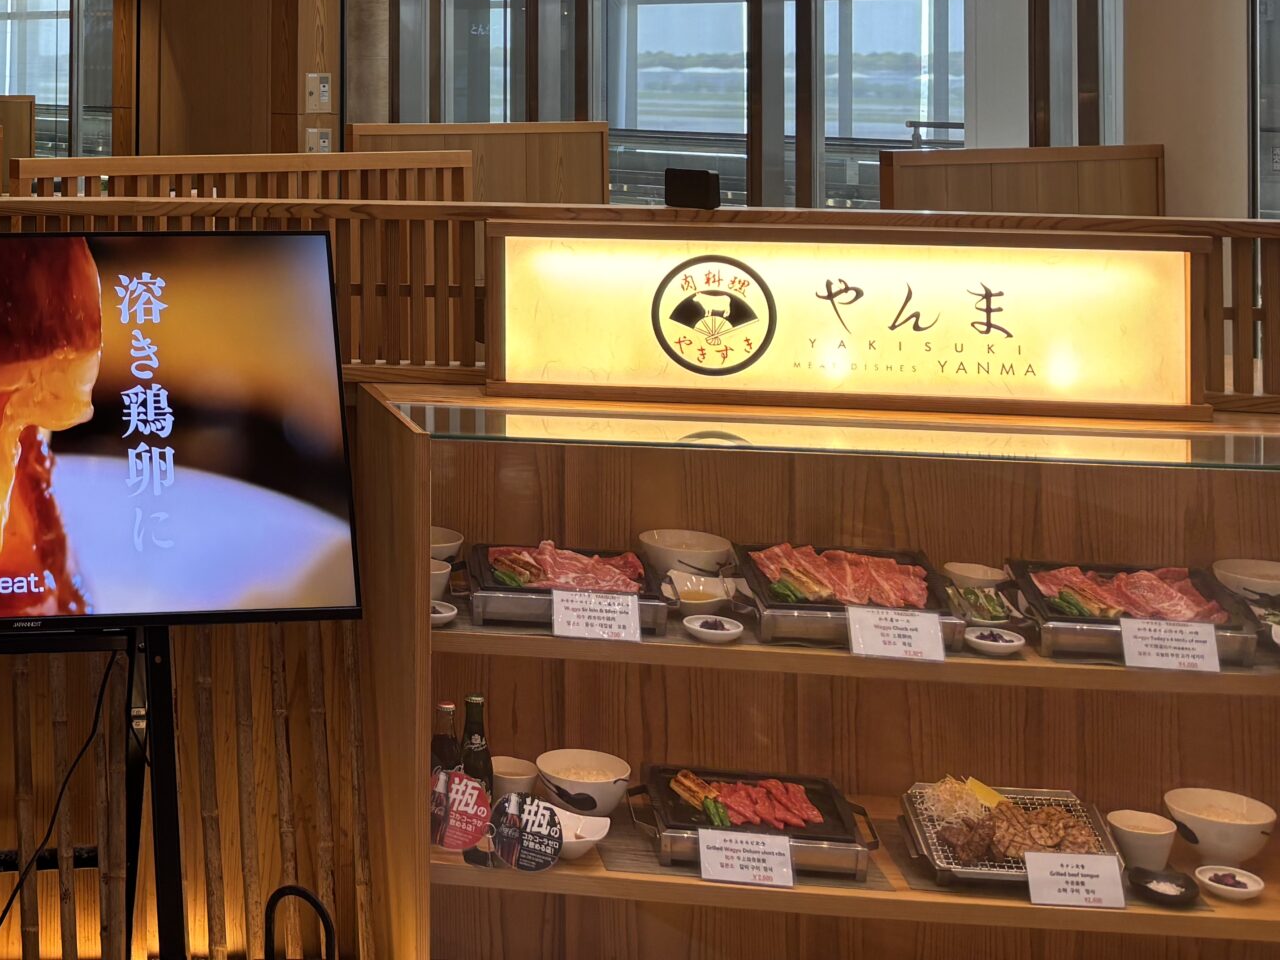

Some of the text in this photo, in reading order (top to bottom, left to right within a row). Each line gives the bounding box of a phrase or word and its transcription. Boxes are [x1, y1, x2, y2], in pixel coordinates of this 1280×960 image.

[680, 270, 751, 299] 肉料理
[816, 278, 1014, 339] やんま
[673, 335, 754, 365] やきすき
[809, 338, 1021, 355] YAKISUKI
[851, 363, 917, 373] DISHES
[938, 360, 1036, 376] YANMA
[114, 272, 175, 554] 溶き鶏卵に
[449, 777, 487, 818] 瓶の
[520, 797, 560, 838] 瓶の
